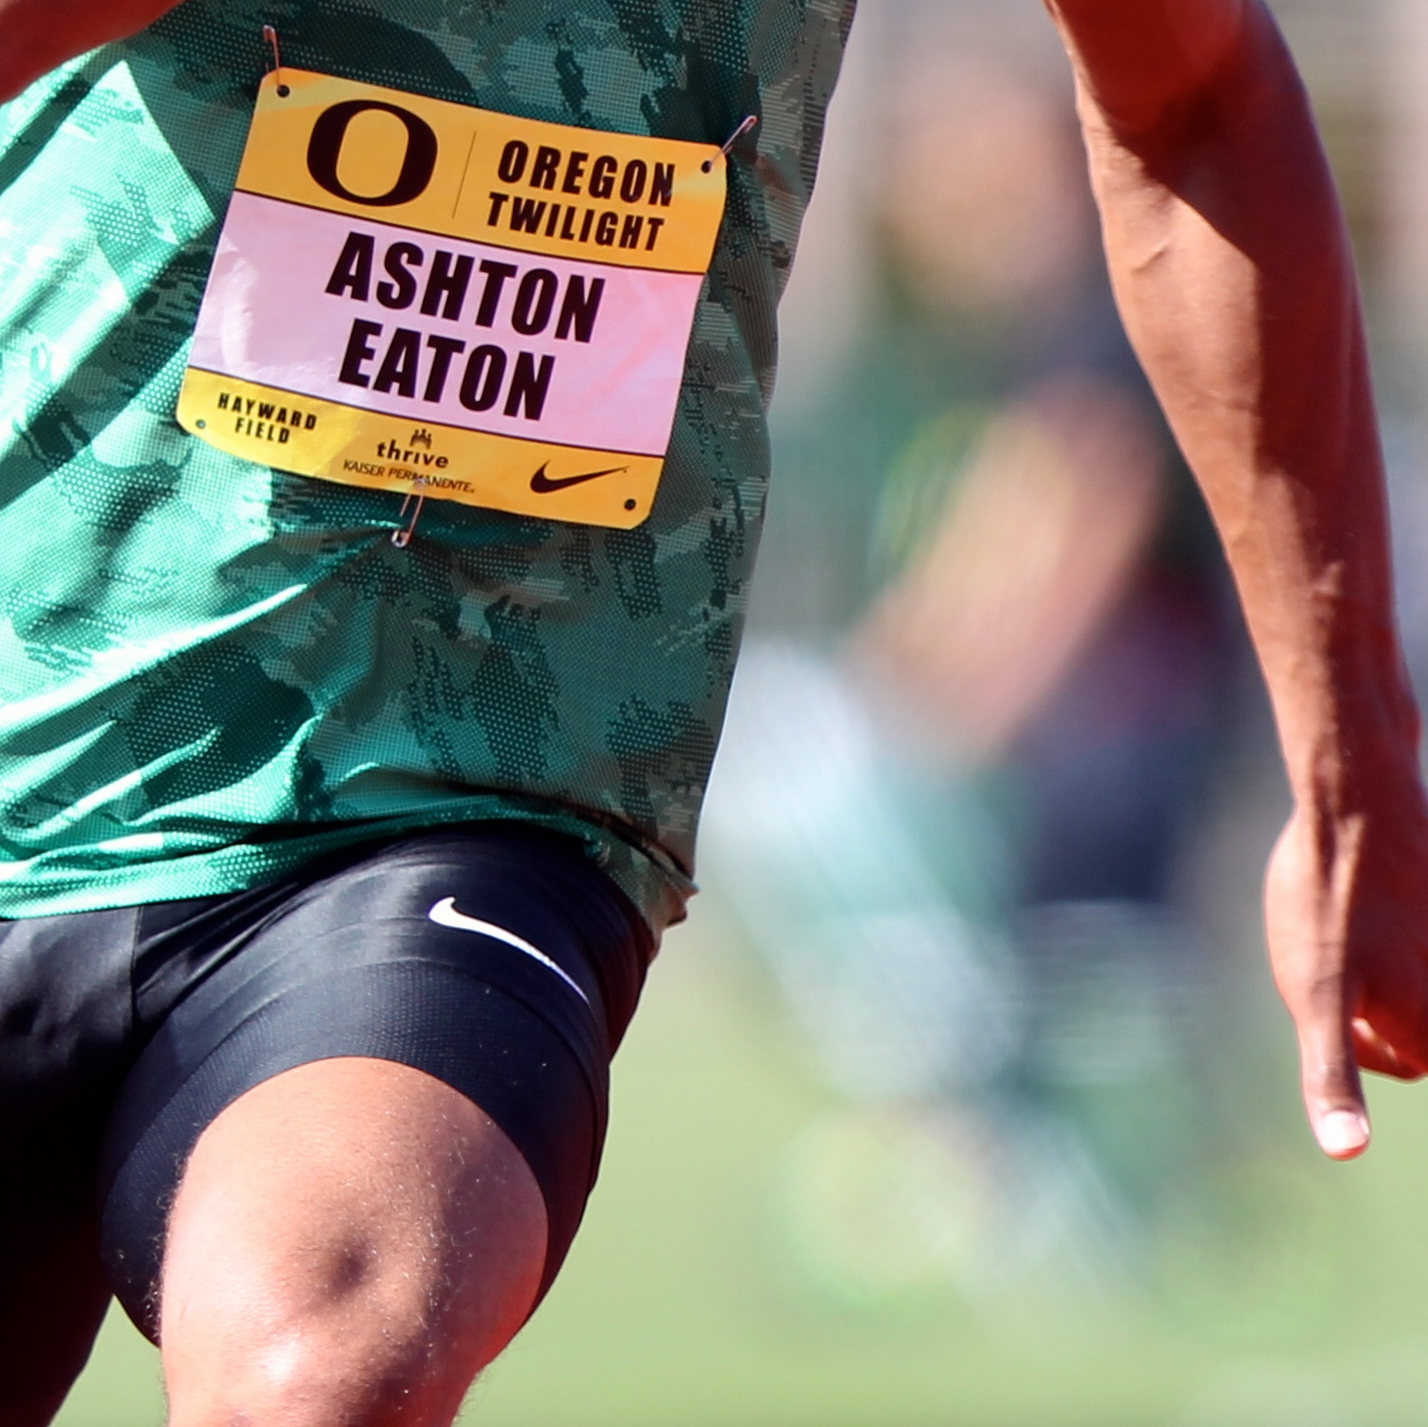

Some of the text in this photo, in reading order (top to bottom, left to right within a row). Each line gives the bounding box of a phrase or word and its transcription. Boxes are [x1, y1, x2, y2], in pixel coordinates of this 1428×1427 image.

[306, 99, 438, 207] O
[497, 140, 675, 207] OREGON
[487, 191, 665, 251] TWILIGHT
[325, 231, 605, 343] ASHTON
[338, 318, 555, 421] EATON
[217, 392, 317, 431] HAYWARD
[234, 416, 291, 444] FIELD
[343, 459, 385, 477] KAISER
[377, 438, 449, 468] thrive
